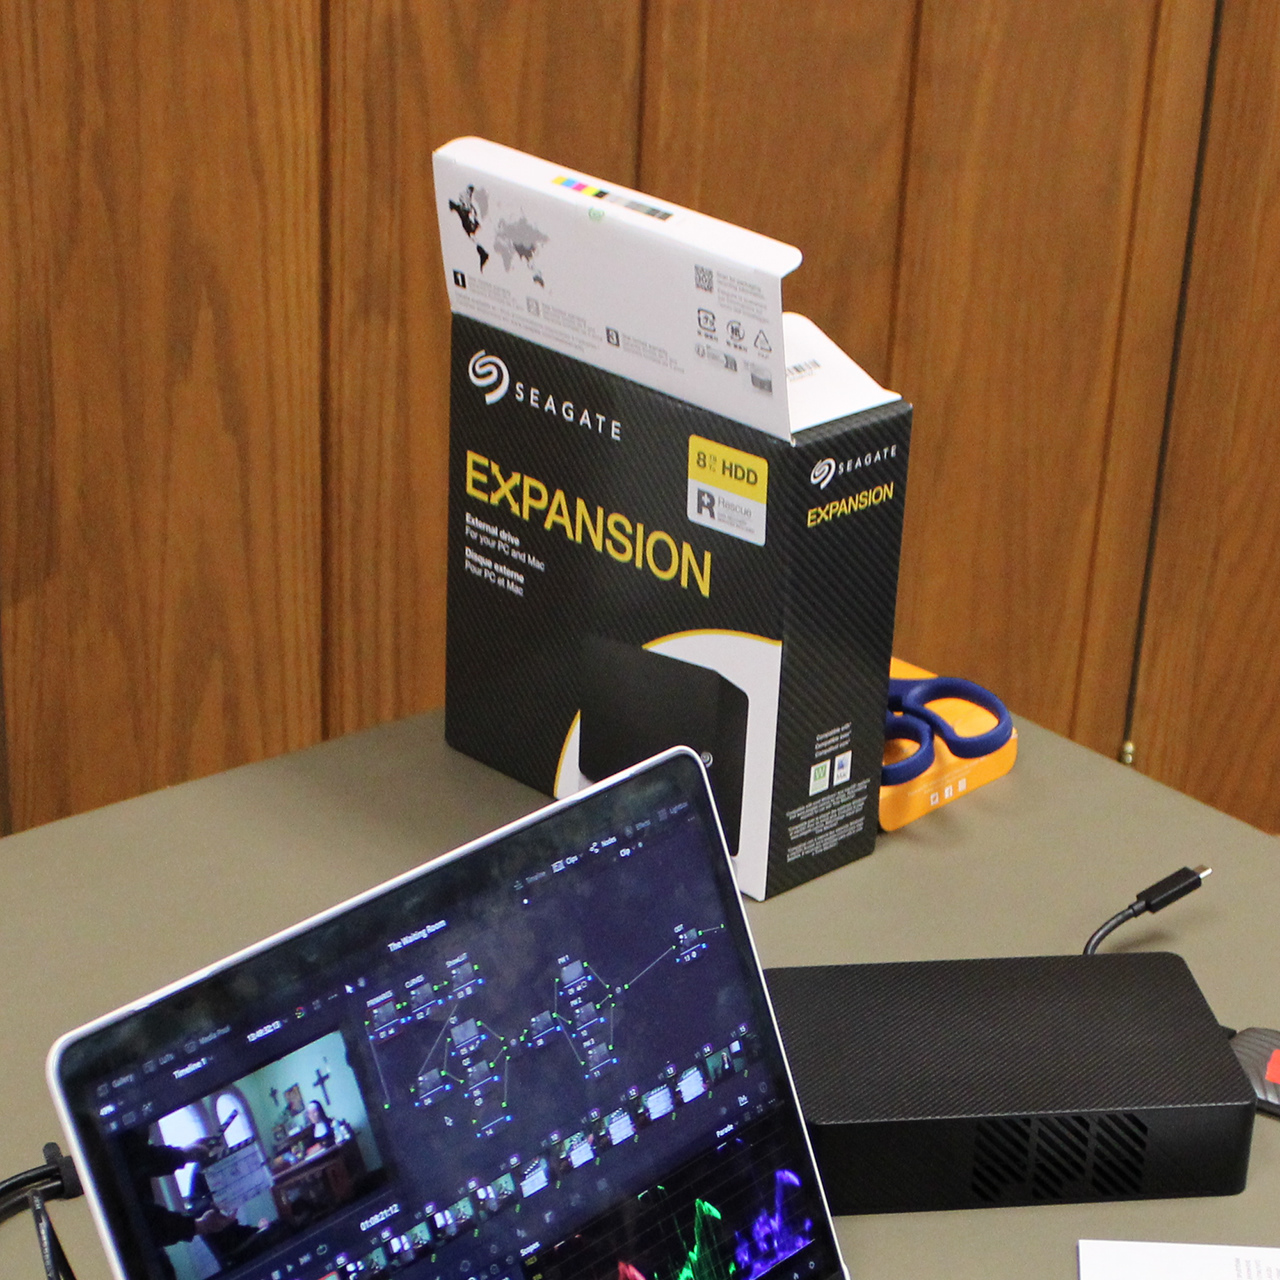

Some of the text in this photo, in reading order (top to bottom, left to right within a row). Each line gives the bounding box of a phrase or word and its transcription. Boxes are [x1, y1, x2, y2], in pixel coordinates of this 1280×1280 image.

[515, 381, 621, 441] SEAGATE
[696, 451, 759, 486] 8 HDD
[838, 444, 897, 475] SEAGATE
[718, 496, 752, 518] Rescue
[807, 481, 894, 528] EXPANSION
[465, 449, 712, 598] EXPANSION
[465, 511, 520, 547] External drive
[465, 525, 545, 572] For your PC and Mac
[465, 545, 525, 584] Disque externe
[465, 559, 483, 577] Pour
[483, 568, 496, 583] PC
[506, 578, 524, 597] Mac
[600, 836, 617, 847] Nodes
[619, 848, 631, 857] Clip
[565, 855, 579, 865] Clips
[387, 919, 447, 952] The Waiting Room
[172, 1061, 203, 1079] Timeline
[715, 1124, 734, 1138] Parade
[359, 1203, 400, 1232] 01:08:21:12
[519, 1241, 541, 1257] Scopes
